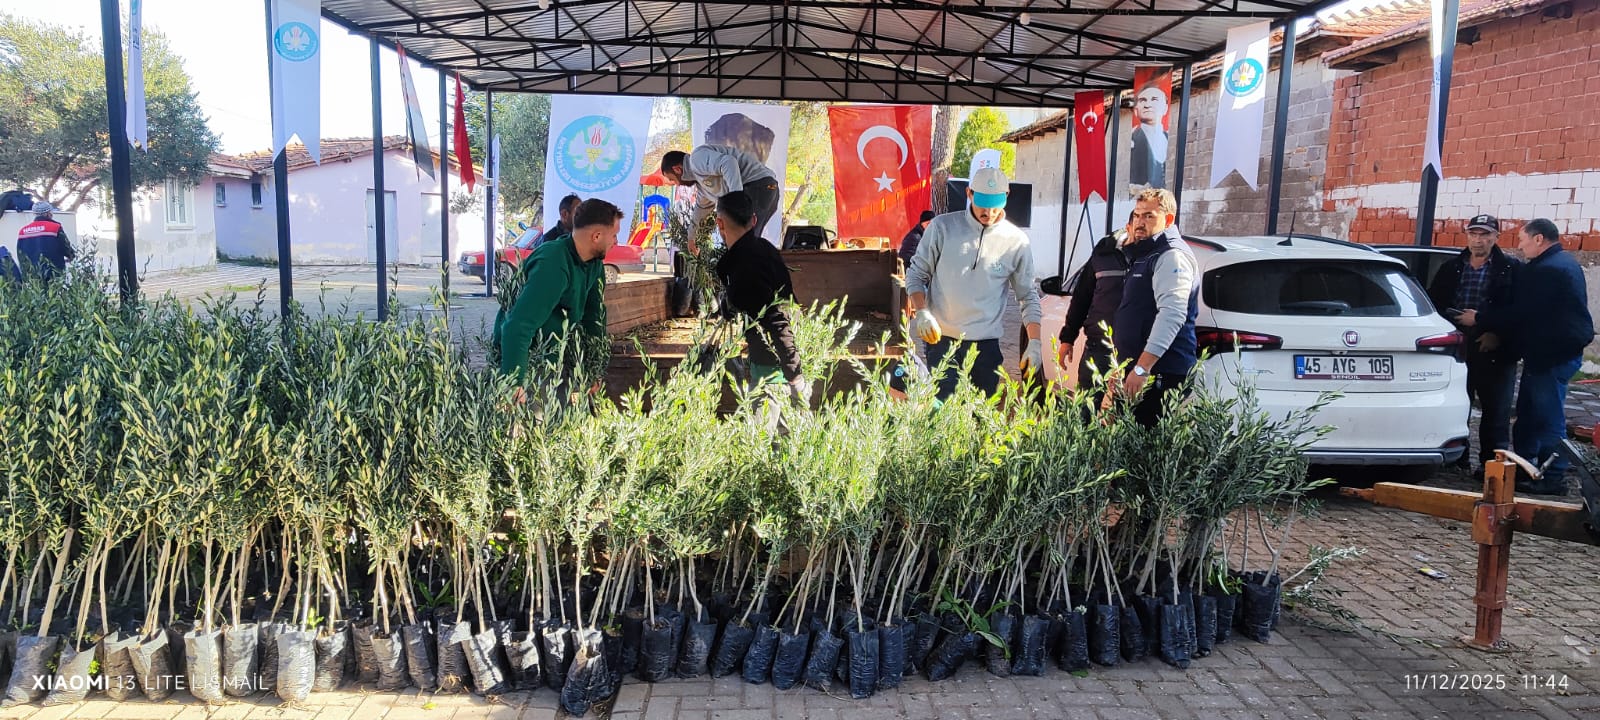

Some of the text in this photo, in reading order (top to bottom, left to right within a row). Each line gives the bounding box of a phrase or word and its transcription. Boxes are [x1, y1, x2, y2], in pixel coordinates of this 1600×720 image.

[1304, 358, 1390, 374] 45 AYG 105
